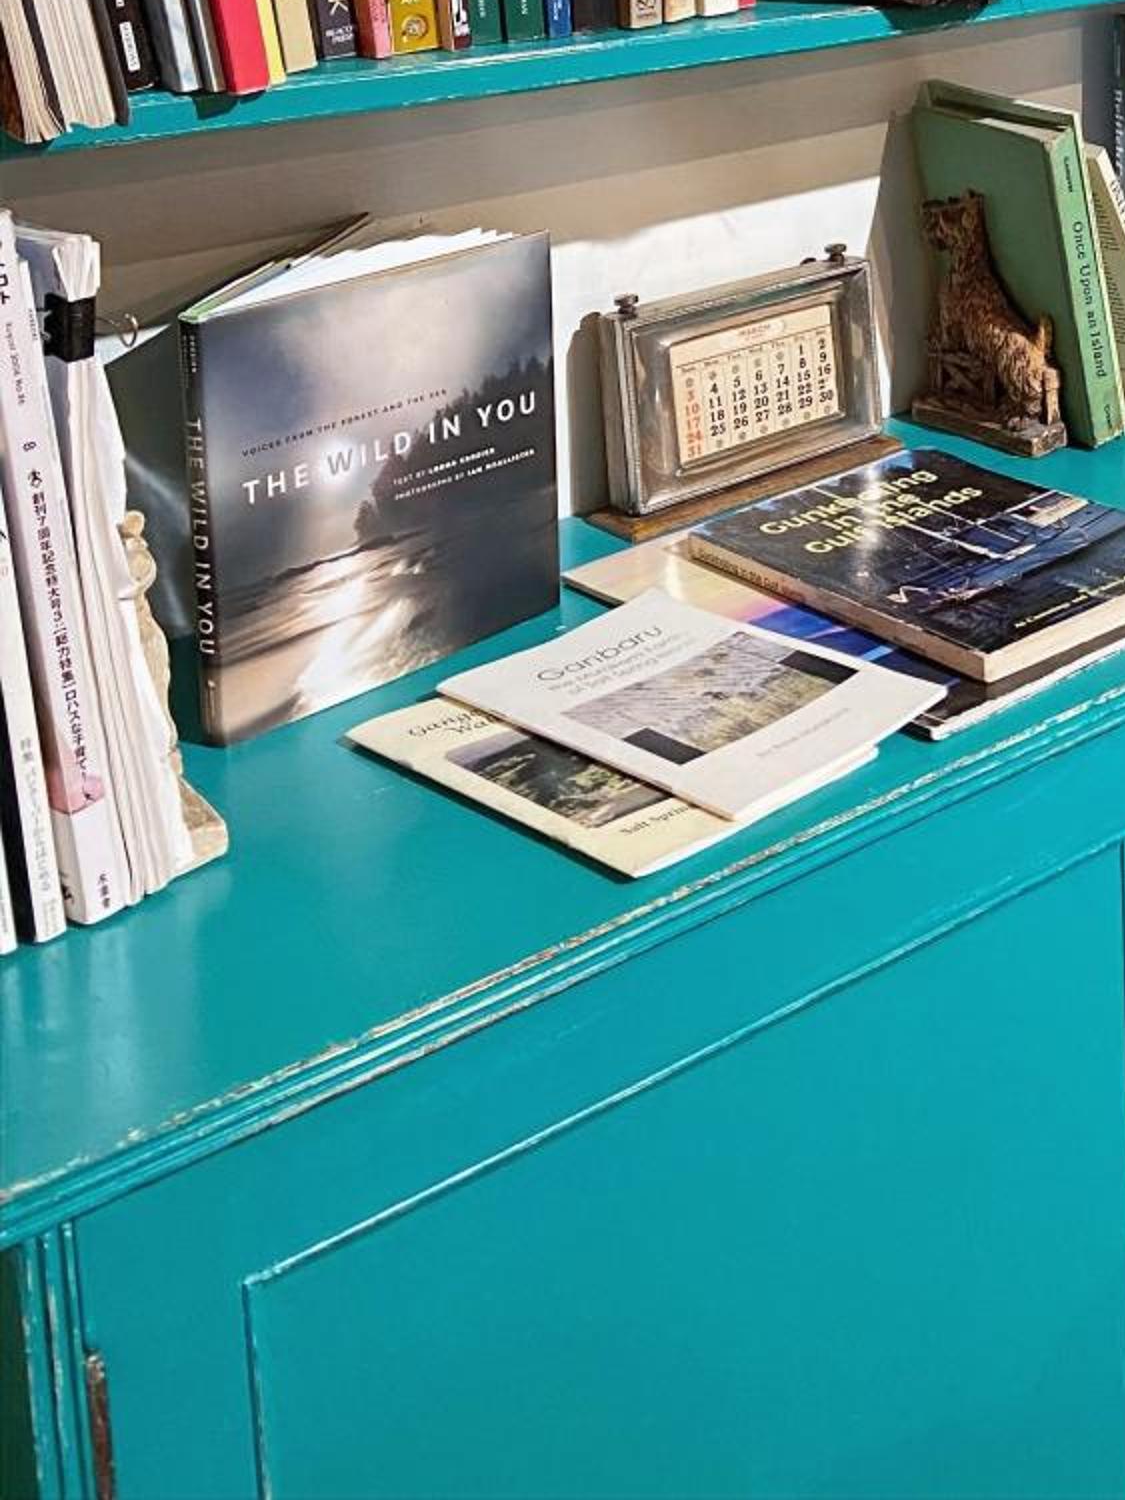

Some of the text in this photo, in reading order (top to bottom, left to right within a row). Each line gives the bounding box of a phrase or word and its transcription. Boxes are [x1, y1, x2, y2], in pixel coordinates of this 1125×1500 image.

[1071, 220, 1108, 379] Once Upon an Island
[708, 363, 832, 409] 11 12 13 14 15 16
[709, 382, 719, 394] 4
[733, 376, 742, 389] 5
[755, 370, 763, 381] 6
[777, 363, 786, 375] 7
[819, 351, 827, 363] 9
[710, 382, 813, 423] 18 19 20 21 22
[710, 389, 835, 437] 25 26 27 28 29 30
[242, 440, 282, 458] VOICES
[317, 421, 337, 434] THE
[242, 390, 536, 505] THE WILD IN YOU
[186, 417, 215, 656] THE WILD IN YOU
[536, 625, 663, 682] Ganbaru
